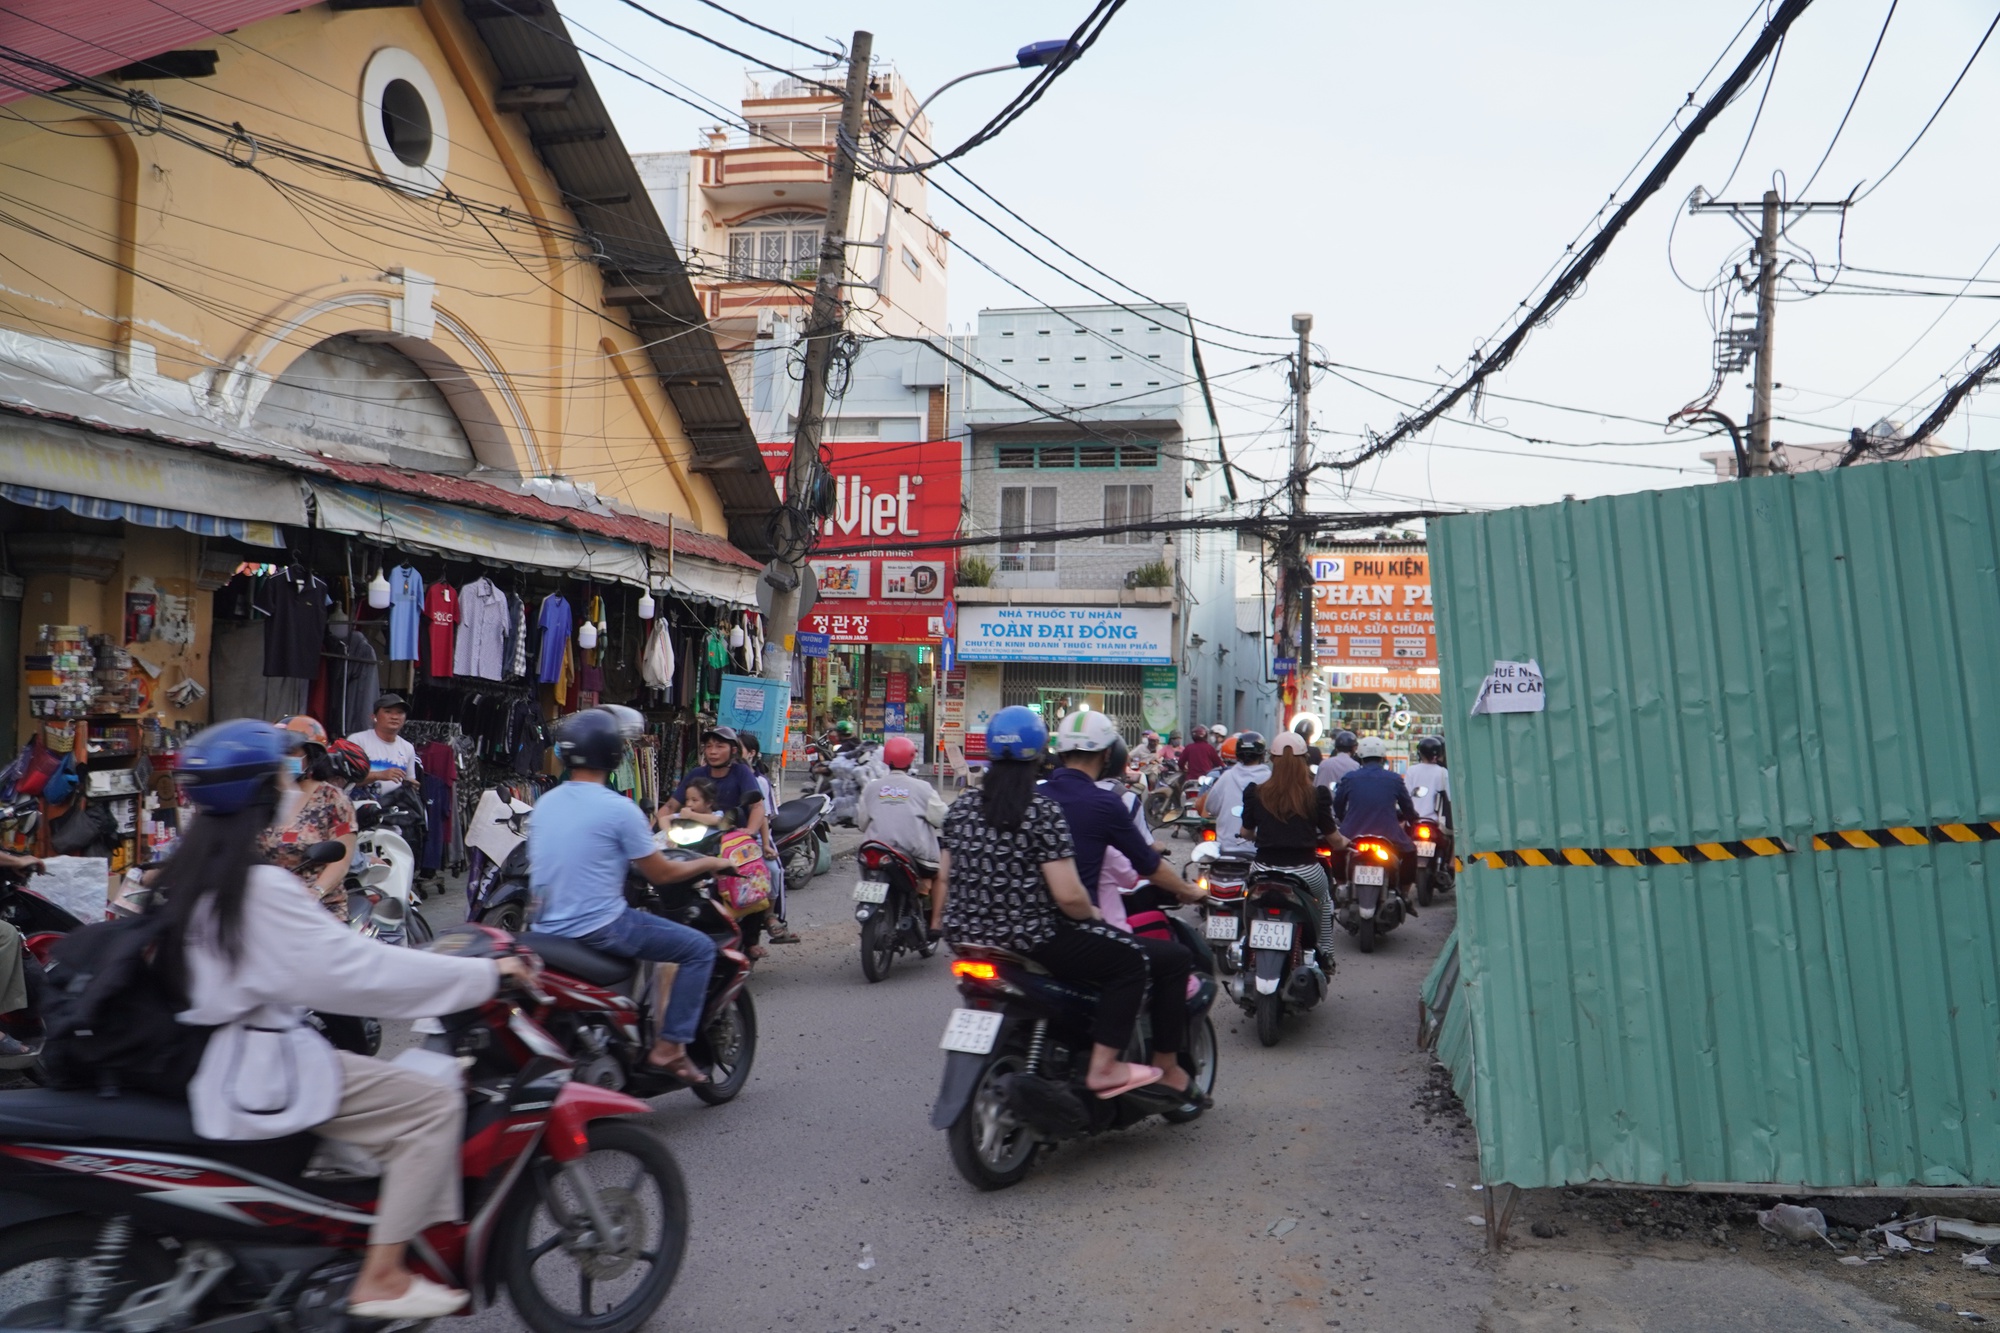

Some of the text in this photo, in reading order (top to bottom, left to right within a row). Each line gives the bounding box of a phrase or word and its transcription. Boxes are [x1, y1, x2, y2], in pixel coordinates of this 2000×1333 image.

[1354, 561, 1384, 579] PHỤ
[1388, 557, 1424, 578] KIỆN
[999, 609, 1123, 620] NHÀ THUỐC TƯ NHÂN
[1340, 607, 1367, 621] CẤP
[1369, 607, 1382, 621] SỈ
[1384, 611, 1393, 621] &
[1396, 607, 1411, 621] LẺ
[813, 615, 869, 634] 정관장
[980, 620, 1138, 641] TOÀN ĐẠI ĐỒNG
[1334, 622, 1362, 635] BÁN,
[1364, 621, 1388, 634] SỬA
[1391, 622, 1426, 634] CHỮA
[965, 640, 1158, 651] CHUYÊN KINH DOANH THUỐC THÀNH PHẨM
[1354, 674, 1437, 691] SỈ & LẺ PHỤ KIỆN ĐIỆN
[1208, 929, 1236, 938] 062.87
[1257, 923, 1284, 935] 79-C1
[1252, 935, 1288, 948] 559.44
